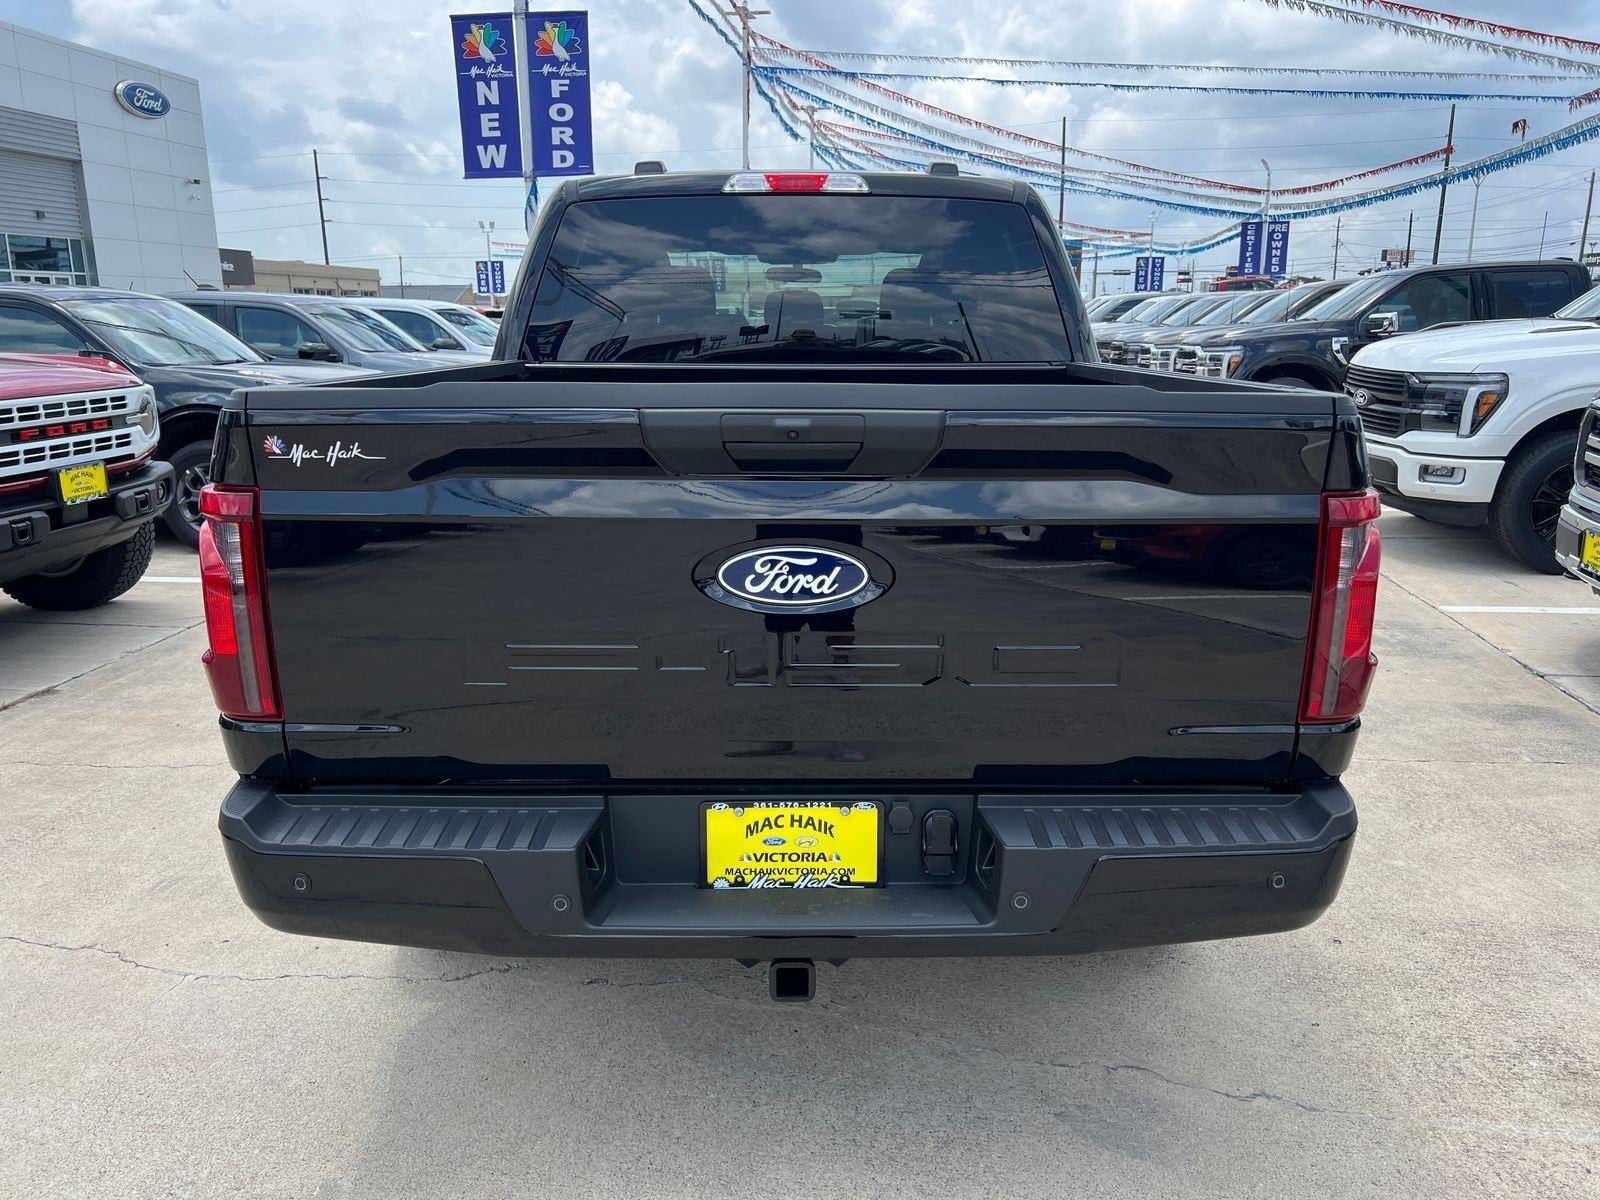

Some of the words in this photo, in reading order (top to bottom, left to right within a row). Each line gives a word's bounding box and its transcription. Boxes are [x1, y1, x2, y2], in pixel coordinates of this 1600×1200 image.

[469, 65, 486, 78] Mac
[541, 63, 559, 76] Mac
[133, 87, 163, 112] Ford
[476, 80, 508, 169] NEW
[548, 79, 575, 168] FORD
[1269, 224, 1288, 232] PRE
[1244, 224, 1257, 274] CERTIFIED
[1271, 232, 1283, 273] OWNED
[480, 273, 488, 292] NEW
[494, 262, 502, 292] HYUNDAI
[1137, 270, 1146, 290] NEW
[1153, 258, 1162, 290] HYUNDAI
[20, 419, 109, 441] FORD
[287, 443, 325, 467] Mac
[326, 440, 368, 467] Haik
[744, 554, 842, 595] Ford
[745, 814, 785, 839] MAC
[789, 814, 836, 839] HAIK
[765, 837, 783, 846] Ford
[752, 852, 828, 863] VICTORIA
[724, 867, 856, 876] MACHAIKVICTORIA.COM
[747, 873, 792, 889] Mac
[793, 872, 844, 889] Haik
